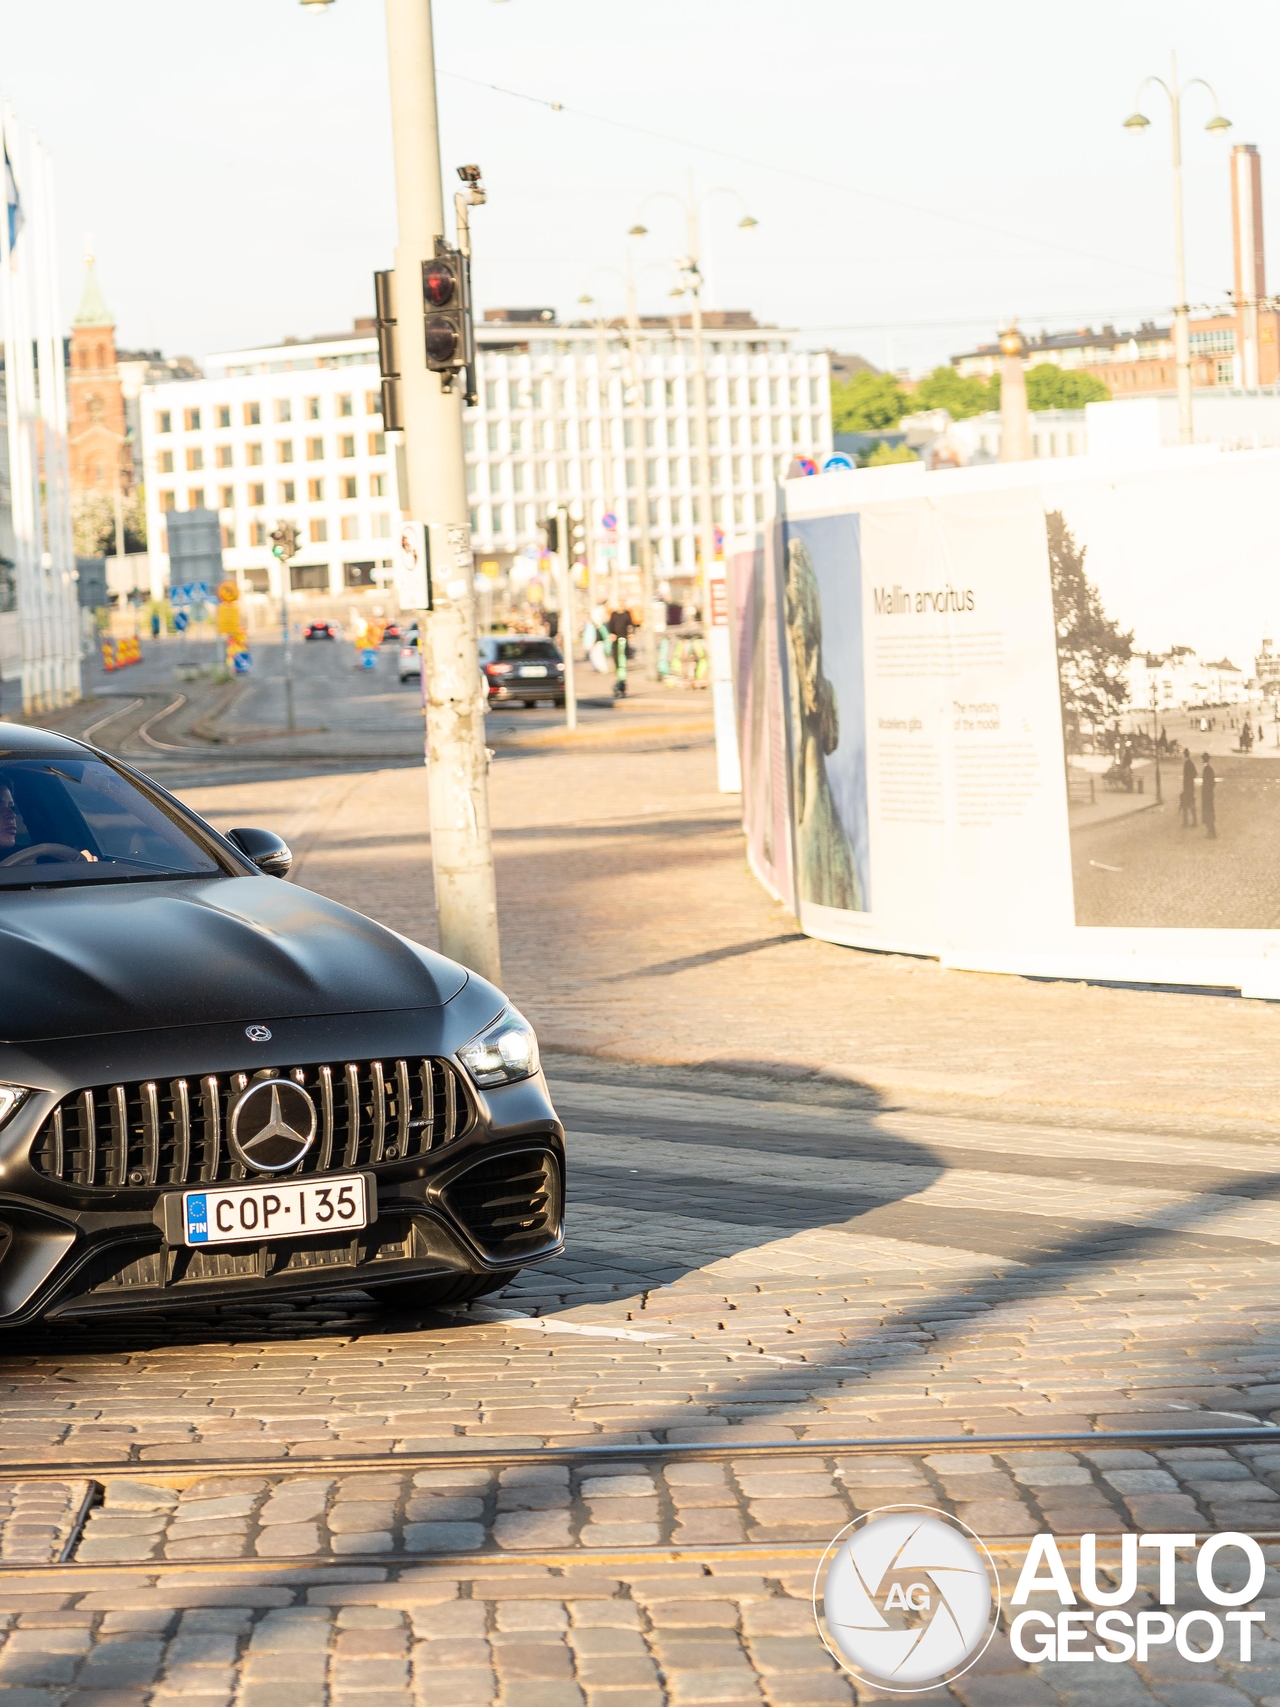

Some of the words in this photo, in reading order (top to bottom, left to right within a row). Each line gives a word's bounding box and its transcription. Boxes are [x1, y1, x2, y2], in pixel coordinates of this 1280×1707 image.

[874, 585, 911, 614] Mallin
[916, 584, 975, 613] arvoitus
[968, 702, 998, 716] mystery
[977, 718, 1000, 730] model
[216, 1186, 356, 1232] COP-135
[189, 1222, 207, 1234] FIN
